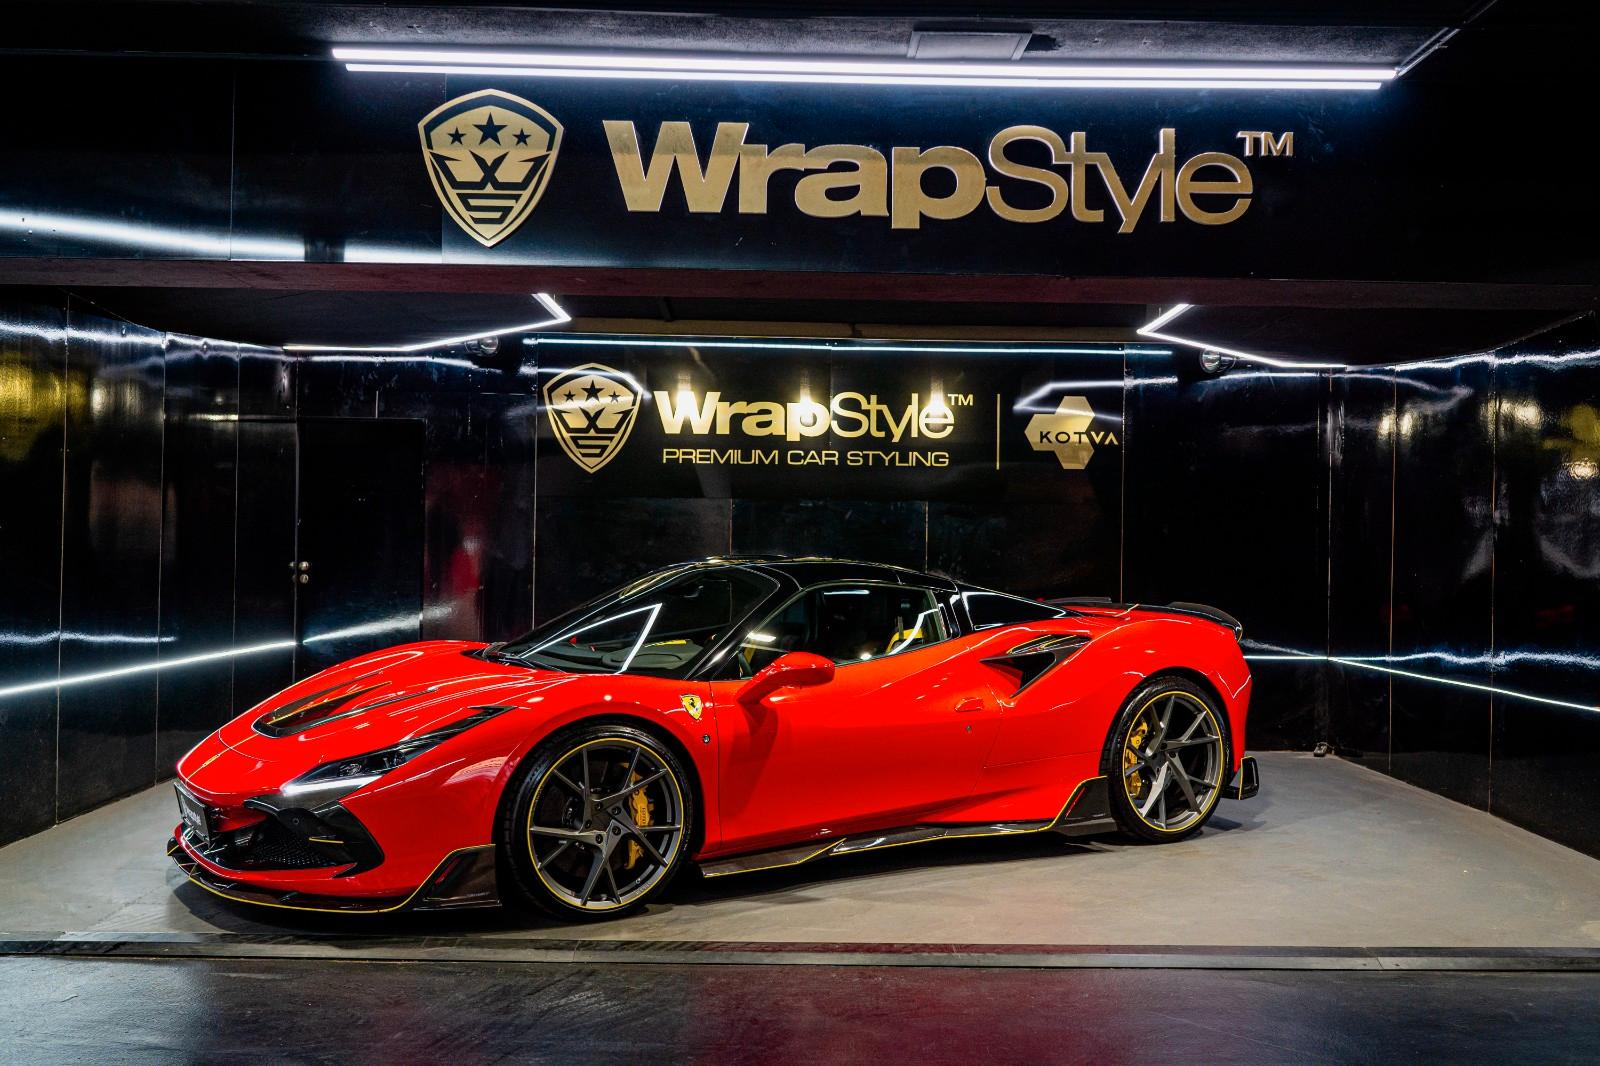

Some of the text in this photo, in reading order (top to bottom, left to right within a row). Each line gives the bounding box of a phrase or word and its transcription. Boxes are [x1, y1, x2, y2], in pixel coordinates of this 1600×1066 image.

[602, 119, 1254, 234] WrapStyle
[653, 390, 955, 443] WrapStyle
[1039, 430, 1119, 446] KOTVA
[662, 448, 950, 467] PREMIUM CAR STYLING
